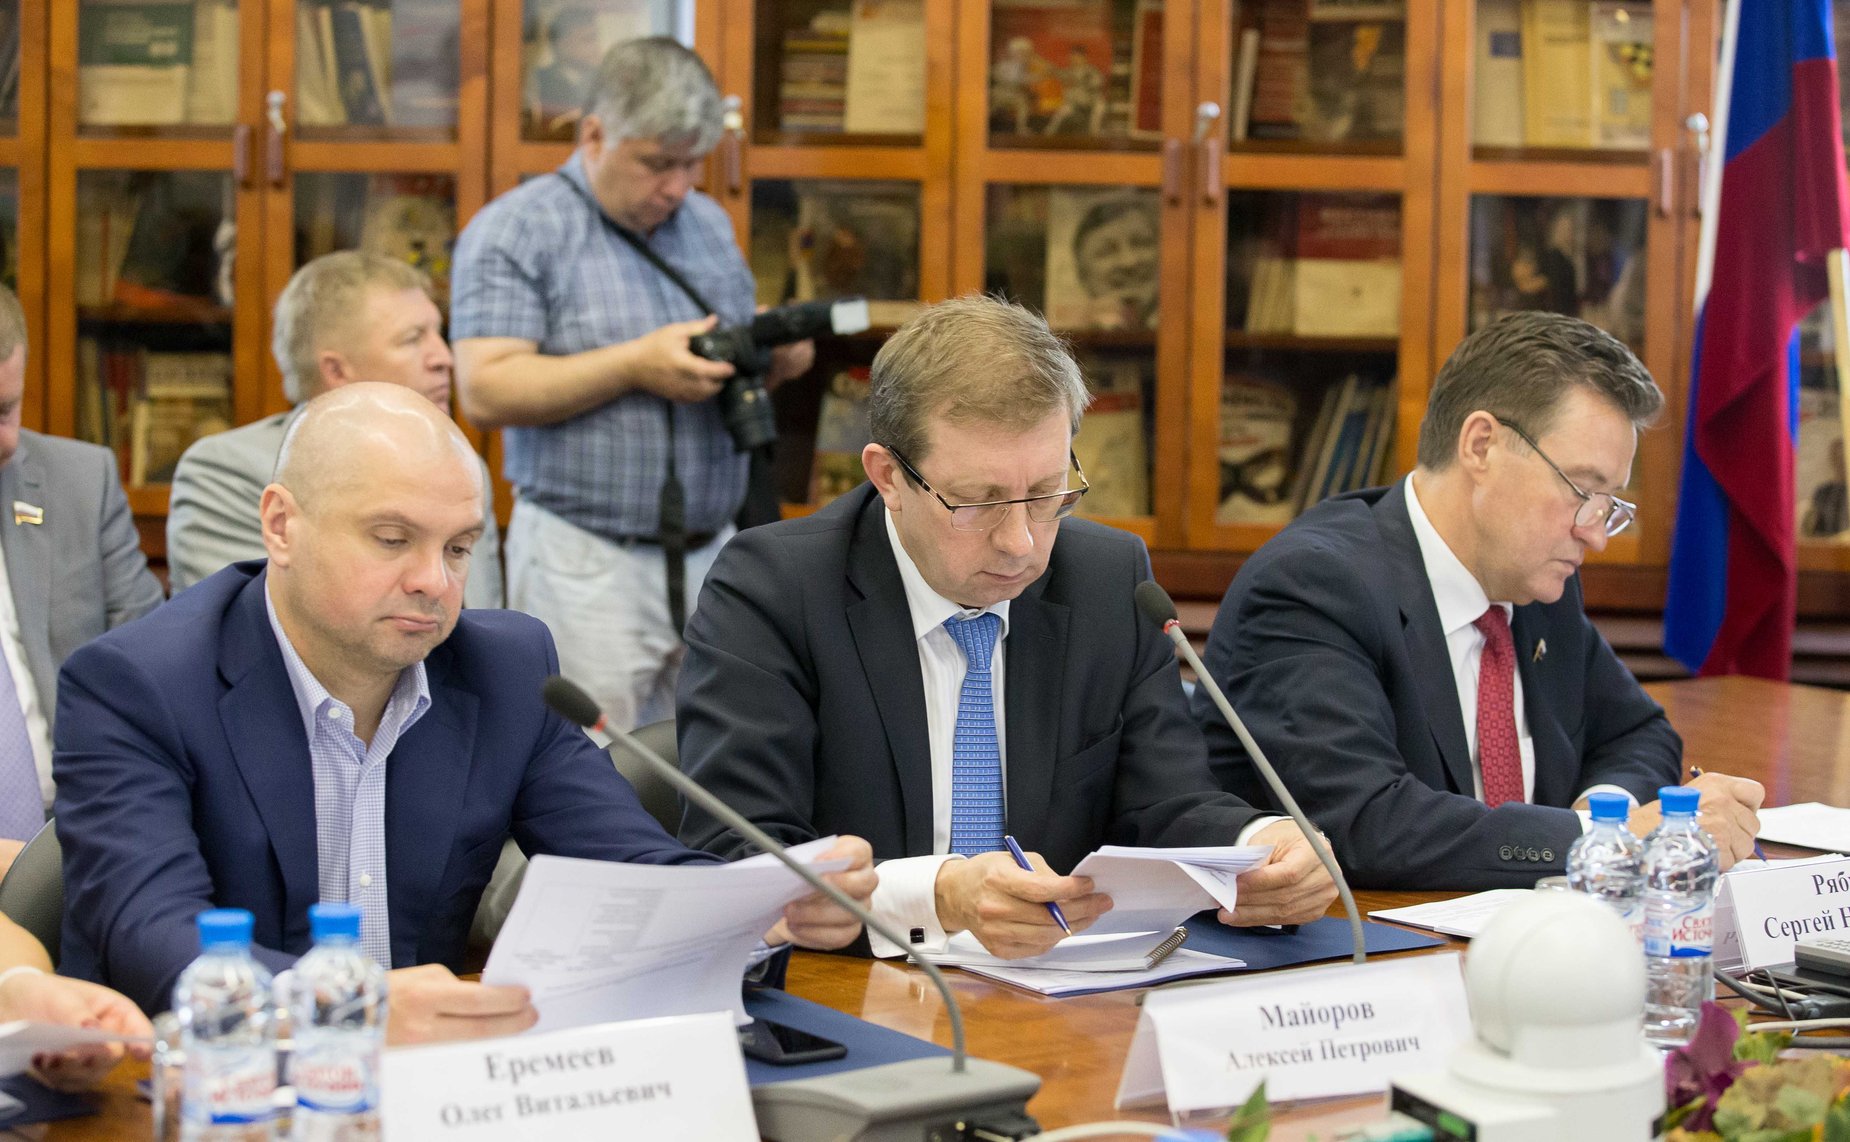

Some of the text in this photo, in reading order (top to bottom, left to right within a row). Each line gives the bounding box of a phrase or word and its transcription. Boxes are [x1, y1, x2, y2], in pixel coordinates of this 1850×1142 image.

[1811, 871, 1850, 895] Ряб
[1764, 909, 1836, 941] Сергей
[1259, 1000, 1375, 1030] Майоров
[484, 1046, 616, 1085] Еремеев
[1226, 1035, 1421, 1072] Алексей Петрович
[439, 1080, 673, 1128] Олег Витальевич
